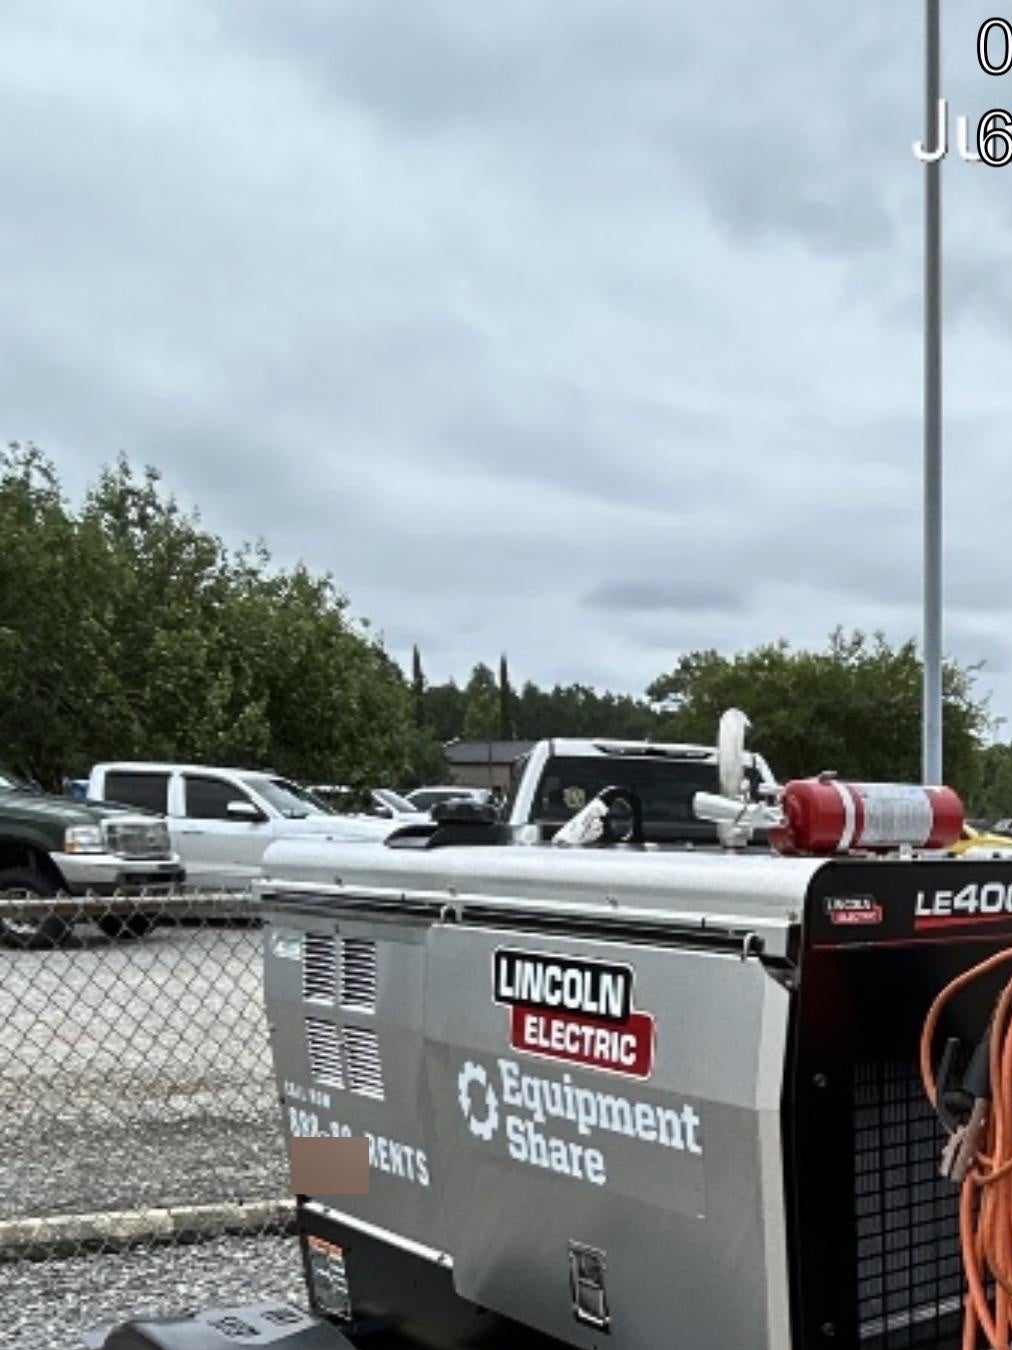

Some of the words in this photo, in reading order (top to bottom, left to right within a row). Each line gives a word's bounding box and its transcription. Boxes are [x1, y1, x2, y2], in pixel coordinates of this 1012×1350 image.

[499, 957, 626, 1017] LINCOLN
[523, 1014, 637, 1066] ELECTRIC
[498, 1058, 703, 1155] Equipment
[506, 1115, 607, 1186] Share
